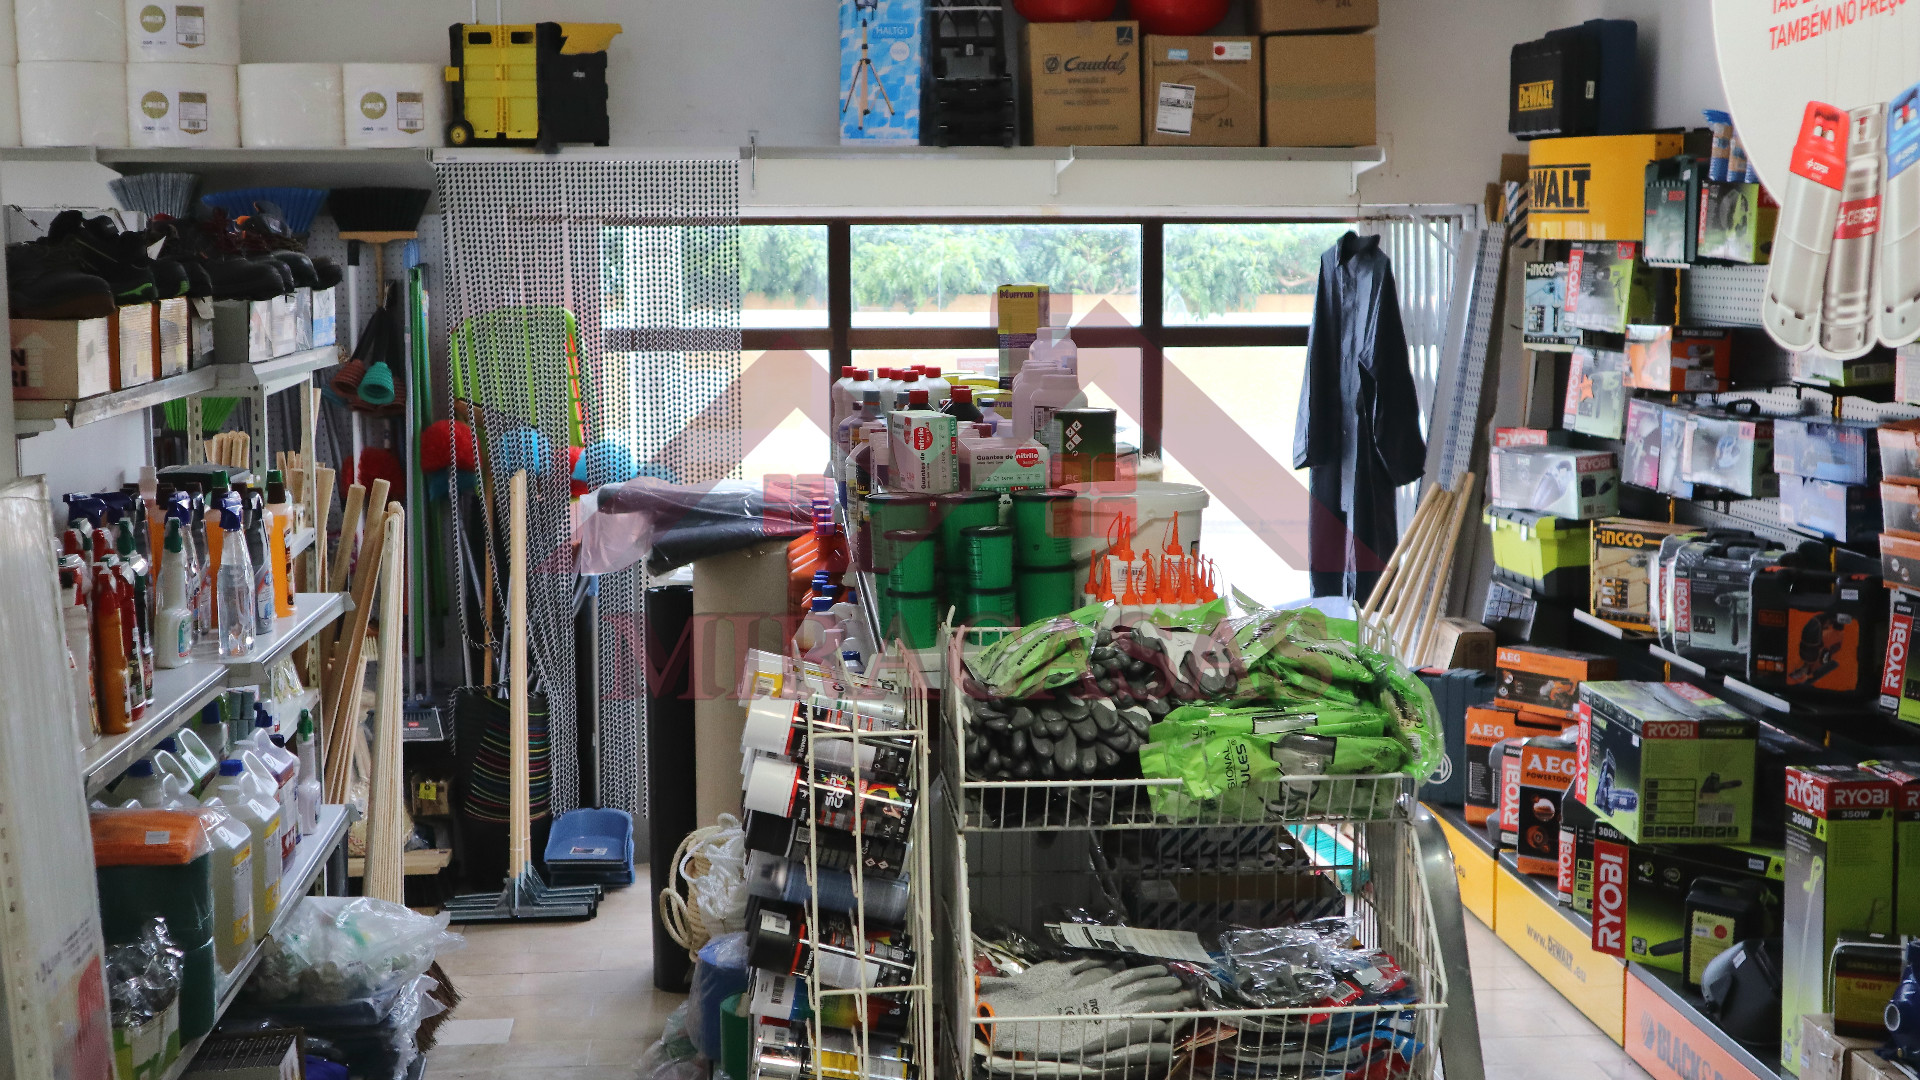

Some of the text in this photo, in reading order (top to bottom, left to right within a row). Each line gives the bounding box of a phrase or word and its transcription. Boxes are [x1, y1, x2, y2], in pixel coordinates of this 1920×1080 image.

[1769, 4, 1832, 51] TAMBÉM
[1836, 1, 1857, 29] NO
[1529, 168, 1591, 209] WALT
[1565, 255, 1581, 307] RYOBI
[1566, 359, 1582, 409] RYOBI
[917, 427, 925, 450] nitrilo
[1677, 581, 1688, 628] RYOBI
[1499, 651, 1521, 662] AEG
[1884, 621, 1910, 689] RYOBI
[1470, 722, 1505, 738] AEG
[1647, 723, 1694, 737] RYOBI
[1527, 753, 1577, 776] AEG
[1576, 712, 1589, 796] RYOBI
[1504, 763, 1521, 825] RYOBI
[1786, 774, 1826, 813] RYOBI
[1834, 788, 1890, 806] RYOBI
[1791, 811, 1813, 830] 350W
[1841, 810, 1870, 819] 350W
[1597, 852, 1623, 950] RYOBI
[1656, 1021, 1703, 1080] BLACK
